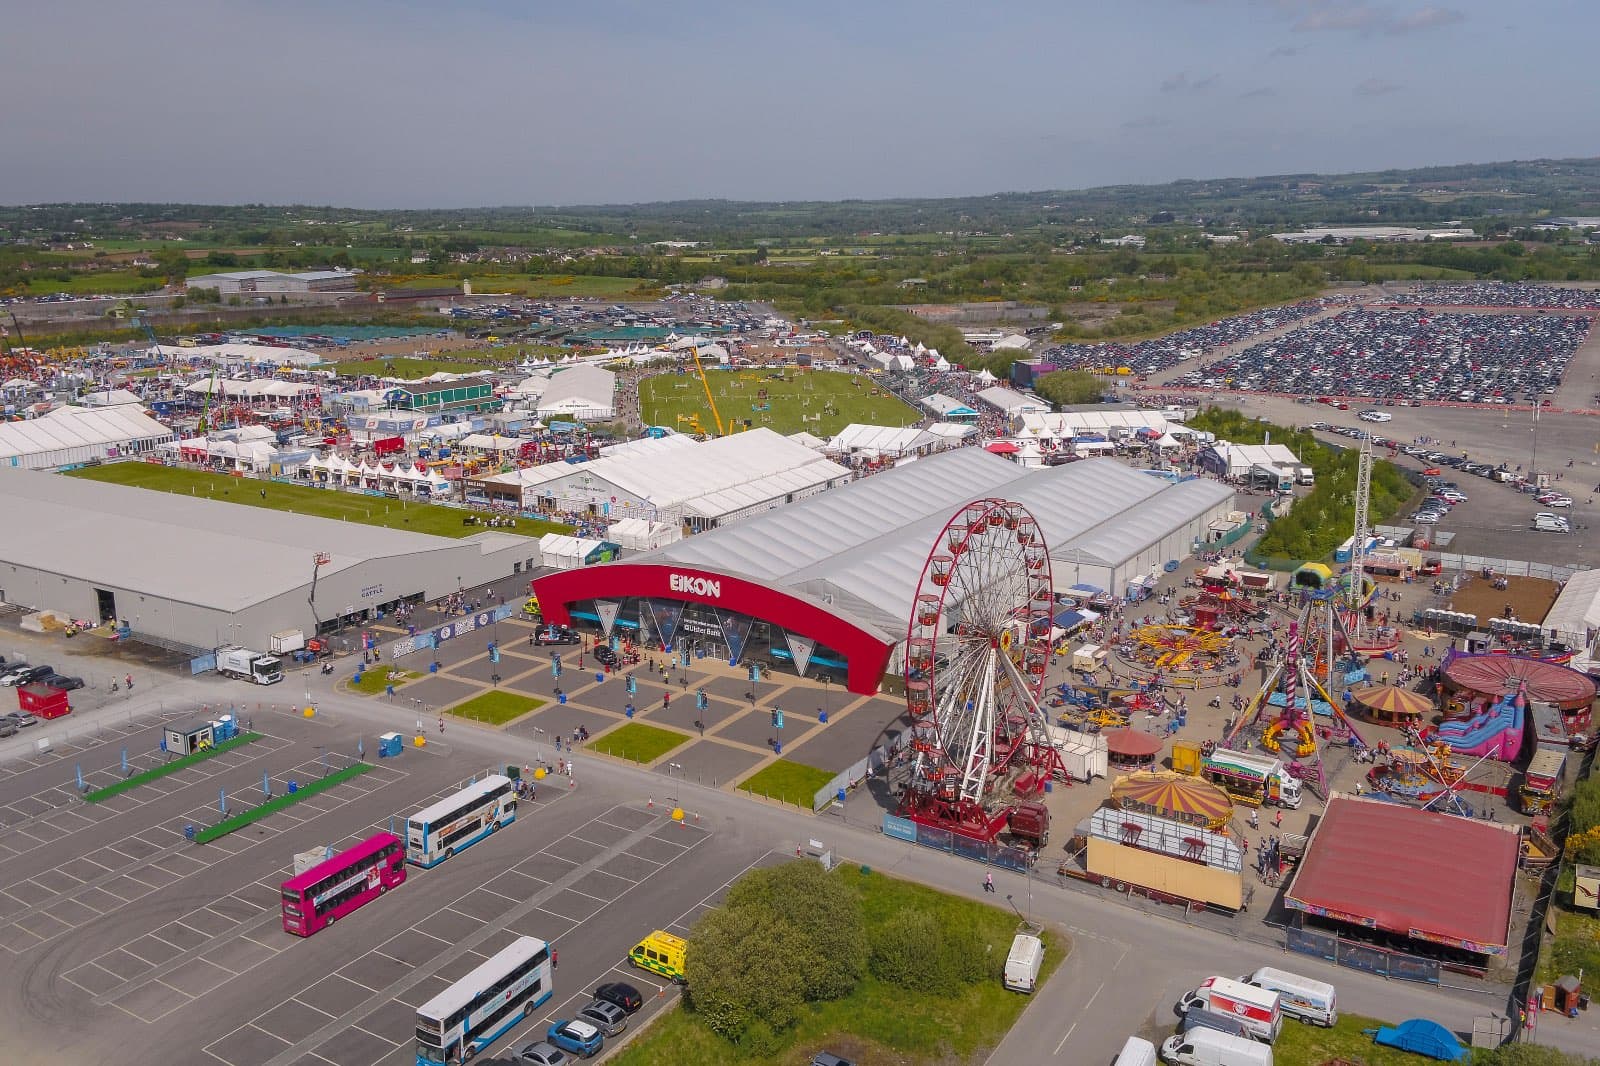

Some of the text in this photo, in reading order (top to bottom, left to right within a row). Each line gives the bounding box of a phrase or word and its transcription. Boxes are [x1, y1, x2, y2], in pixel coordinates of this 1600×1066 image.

[670, 574, 720, 598] EIKON
[690, 625, 721, 637] Ulster Bank
